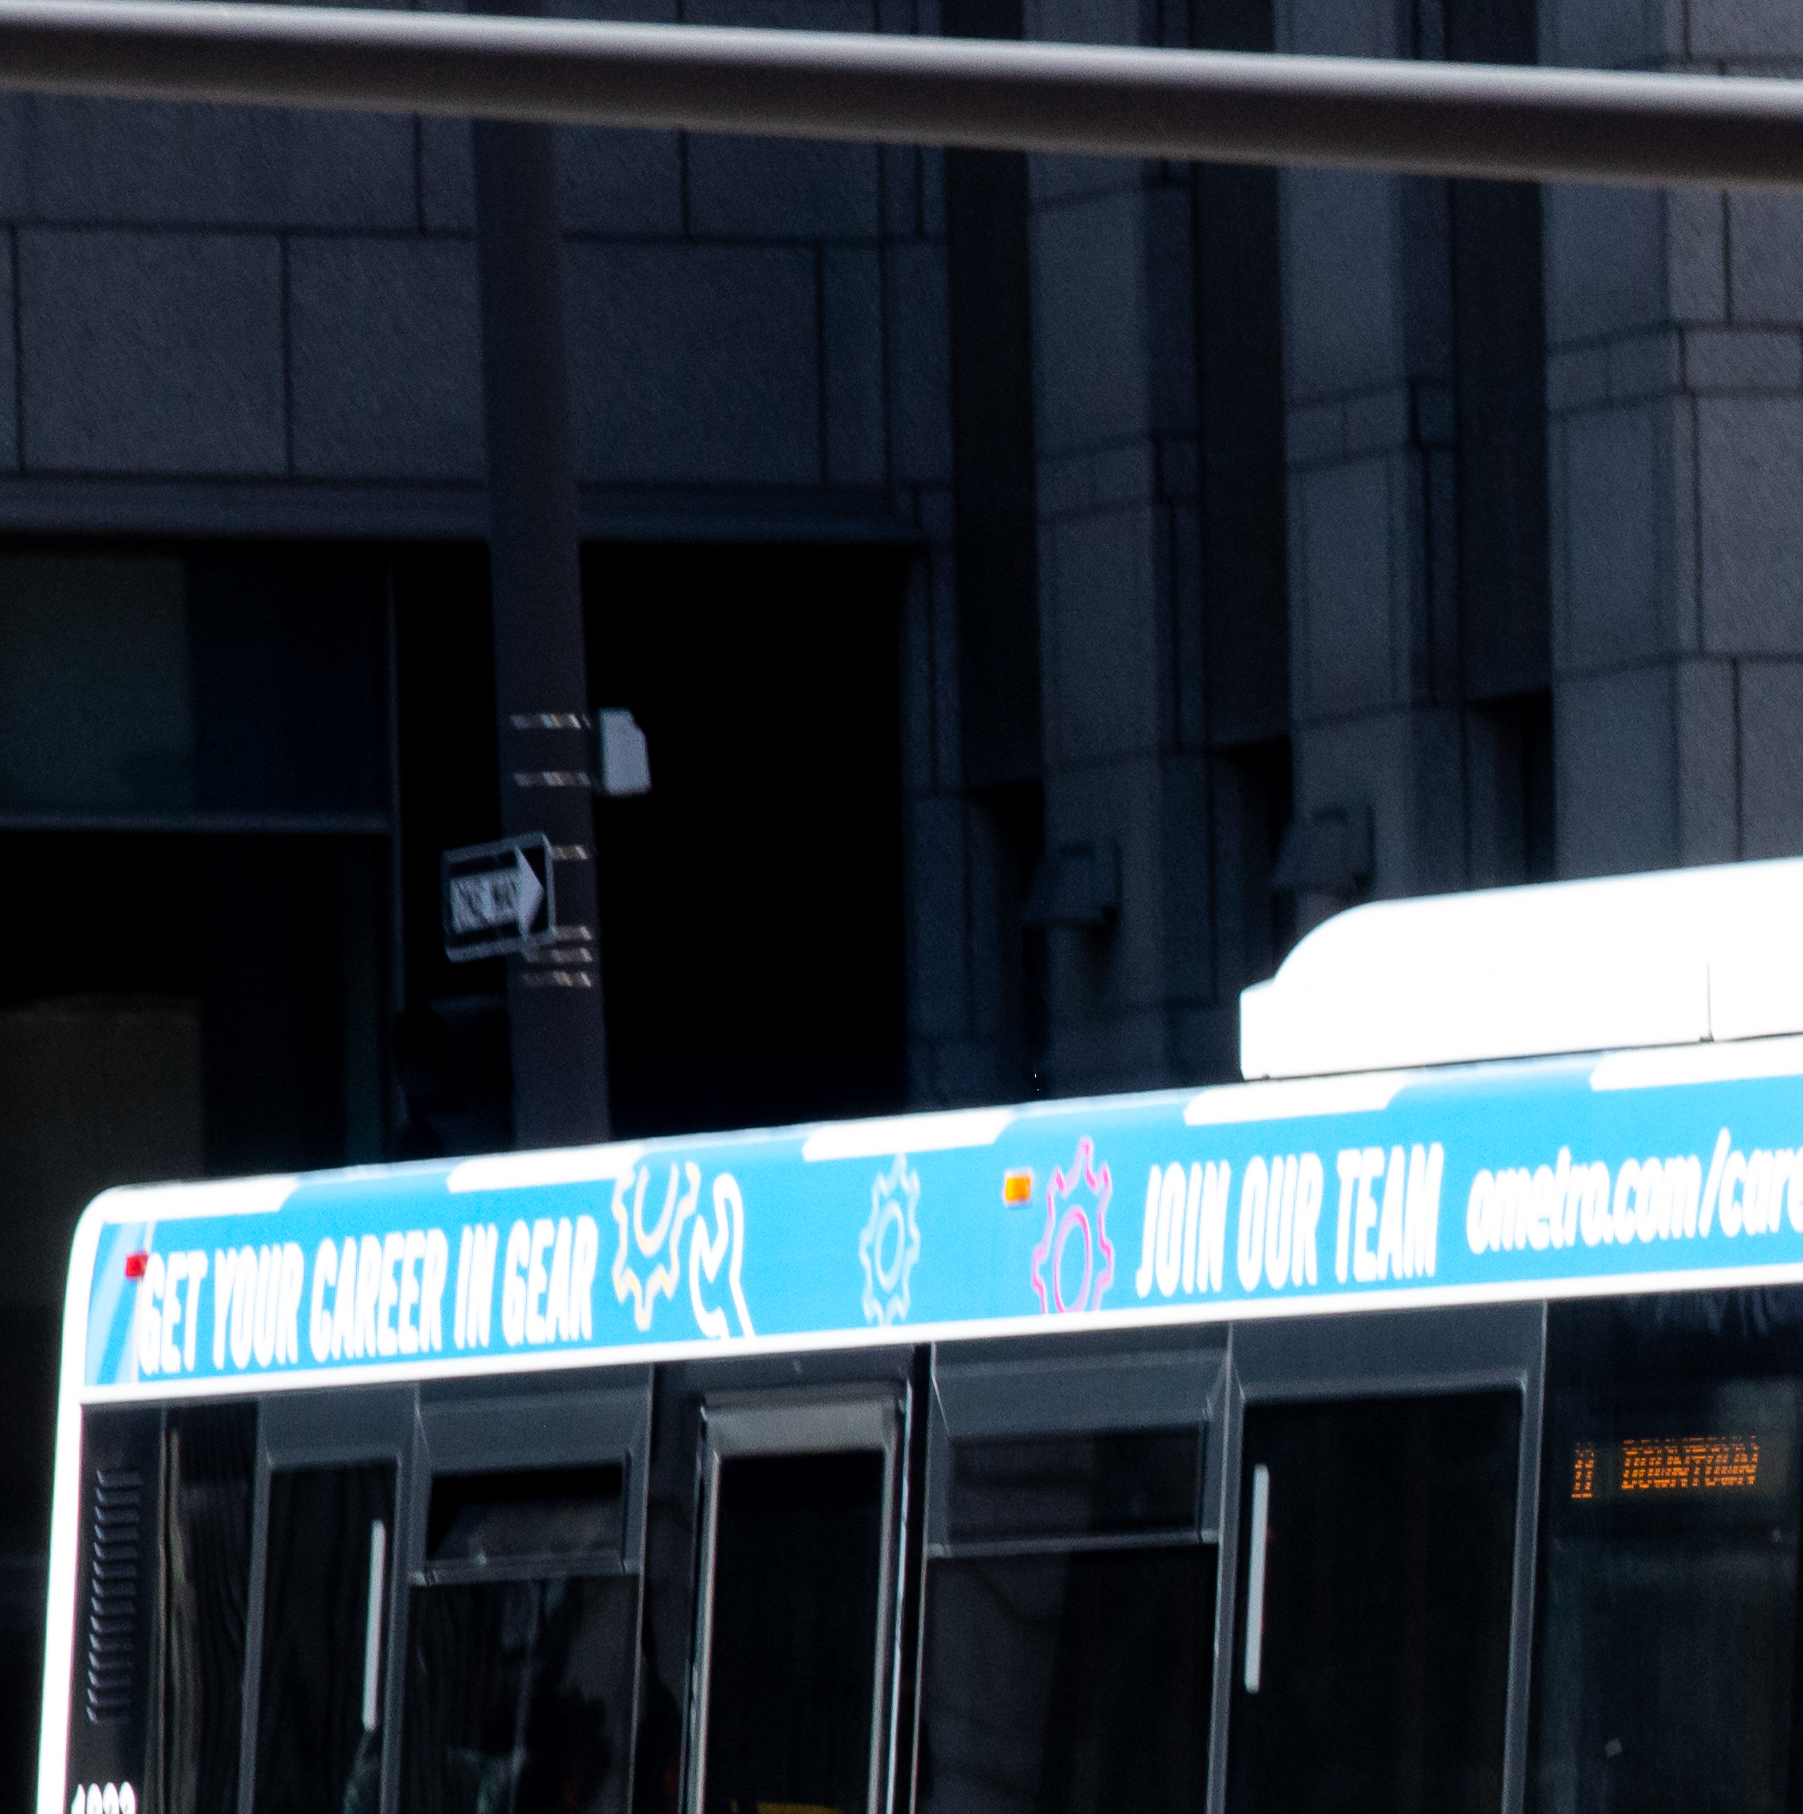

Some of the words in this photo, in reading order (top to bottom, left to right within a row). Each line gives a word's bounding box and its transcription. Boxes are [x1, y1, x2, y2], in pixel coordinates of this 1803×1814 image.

[138, 1250, 208, 1376] GET
[212, 1241, 305, 1371] YOUR
[309, 1227, 448, 1364] CAREER
[453, 1222, 499, 1350] IN
[502, 1214, 599, 1348] GEAR
[1135, 1159, 1232, 1299] JOIN
[1236, 1152, 1324, 1293] OUR
[1335, 1141, 1445, 1284] TEAM
